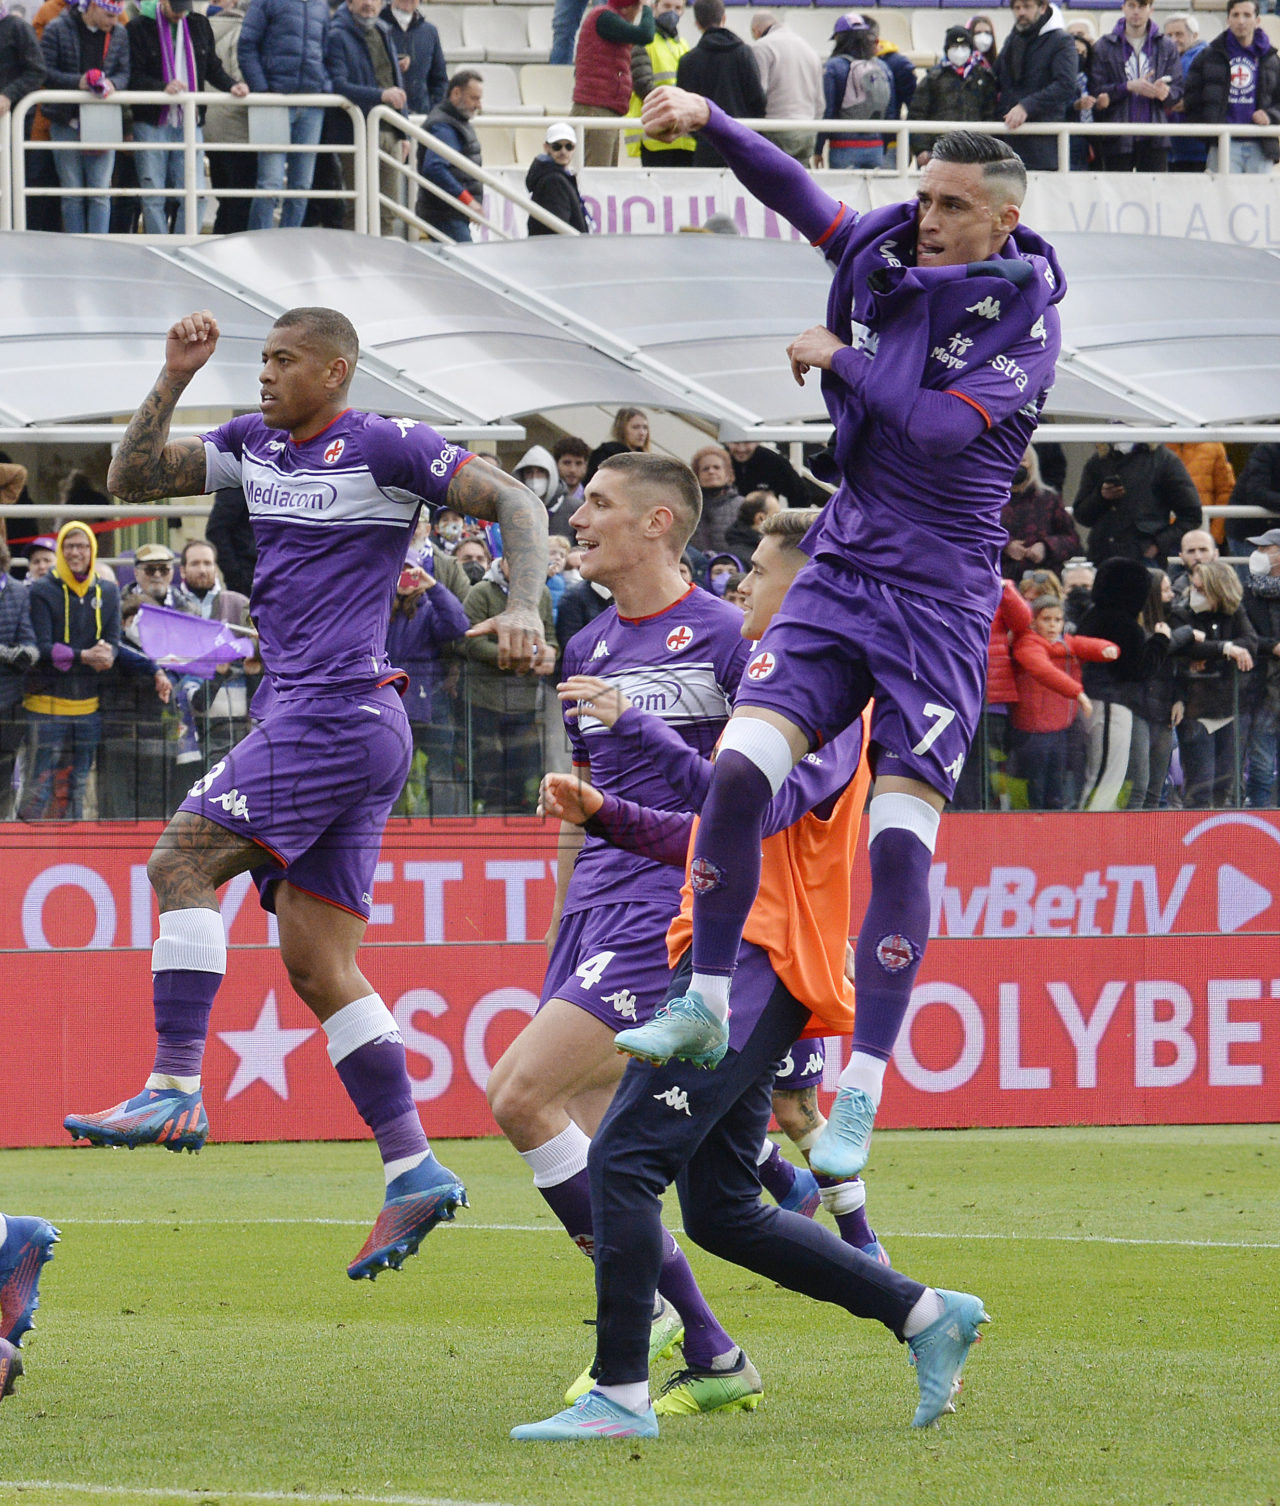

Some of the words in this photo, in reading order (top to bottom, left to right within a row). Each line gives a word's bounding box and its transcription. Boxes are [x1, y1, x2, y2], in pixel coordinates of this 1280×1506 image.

[930, 346, 968, 370] Meyer
[988, 354, 1029, 393] stra
[245, 480, 324, 510] Mediacom
[911, 702, 956, 756] 7
[187, 761, 226, 798] 8
[575, 950, 617, 991] 4
[893, 978, 1280, 1093] OLYBE
